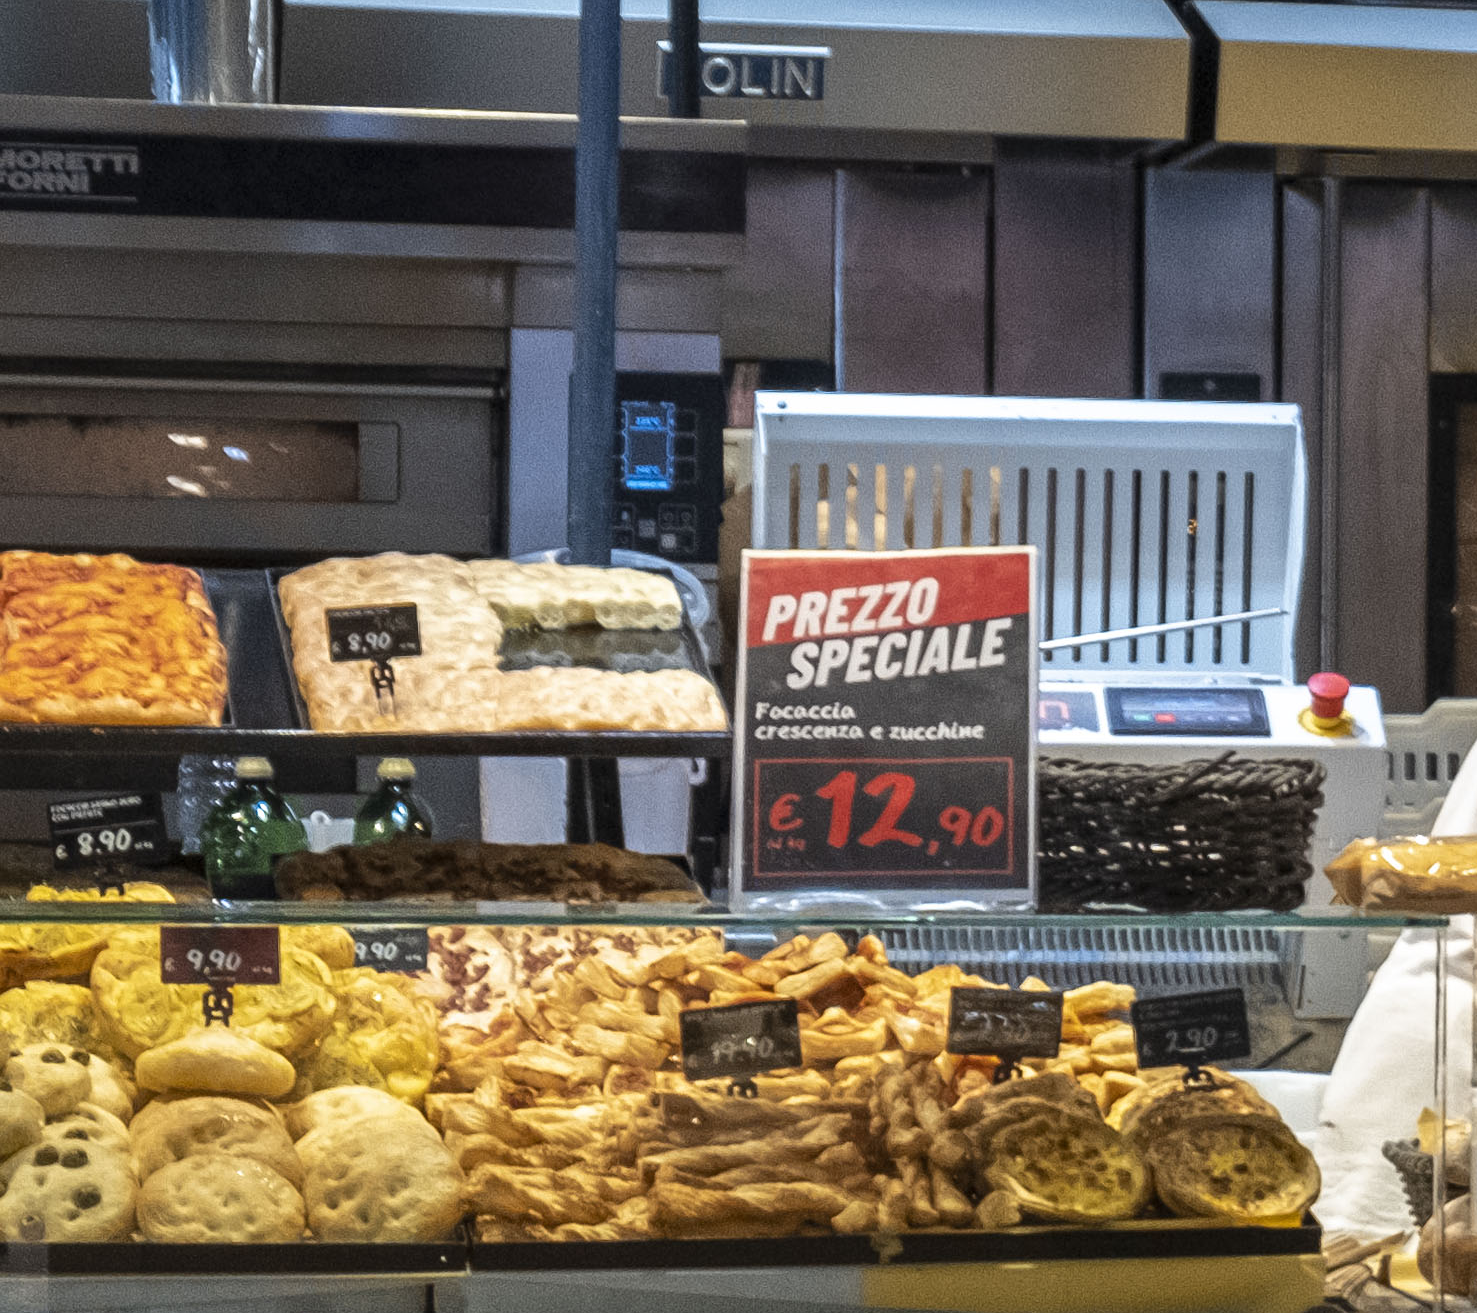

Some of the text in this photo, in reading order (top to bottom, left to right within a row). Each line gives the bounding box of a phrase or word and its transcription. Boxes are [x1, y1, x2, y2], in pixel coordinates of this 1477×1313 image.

[701, 56, 816, 98] OLIN
[762, 577, 939, 642] PREZZO
[786, 617, 1012, 690] SPECIALE
[754, 701, 856, 720] Focaccia
[754, 721, 985, 740] crescenza e zucchine
[768, 770, 1005, 856] € 12,90
